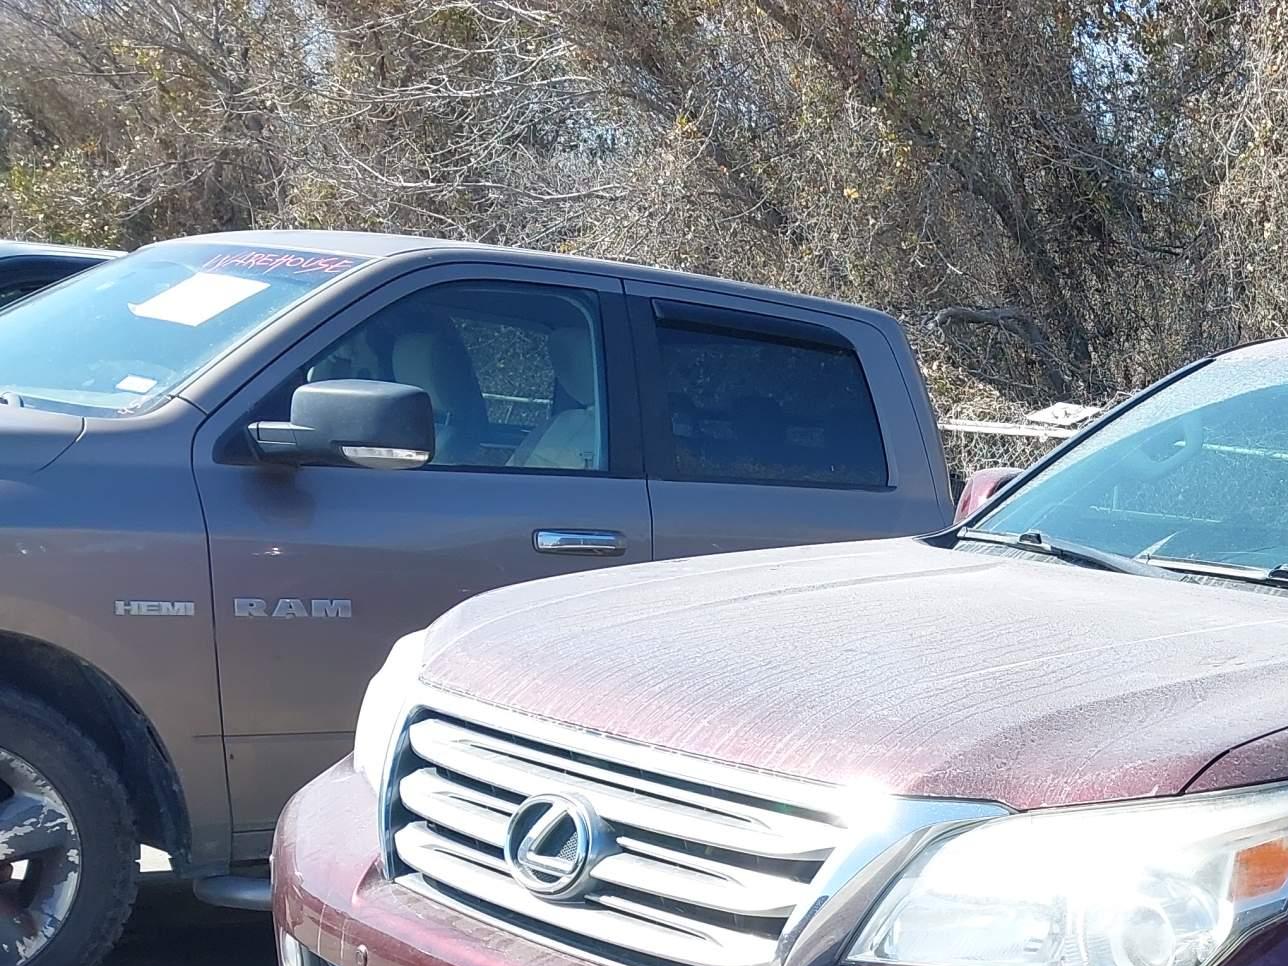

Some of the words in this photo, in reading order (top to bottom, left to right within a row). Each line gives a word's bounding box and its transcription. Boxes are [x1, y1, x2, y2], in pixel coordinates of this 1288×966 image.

[202, 251, 355, 275] WAREHOUSE
[115, 600, 195, 616] HEMI
[234, 598, 352, 618] RAM
